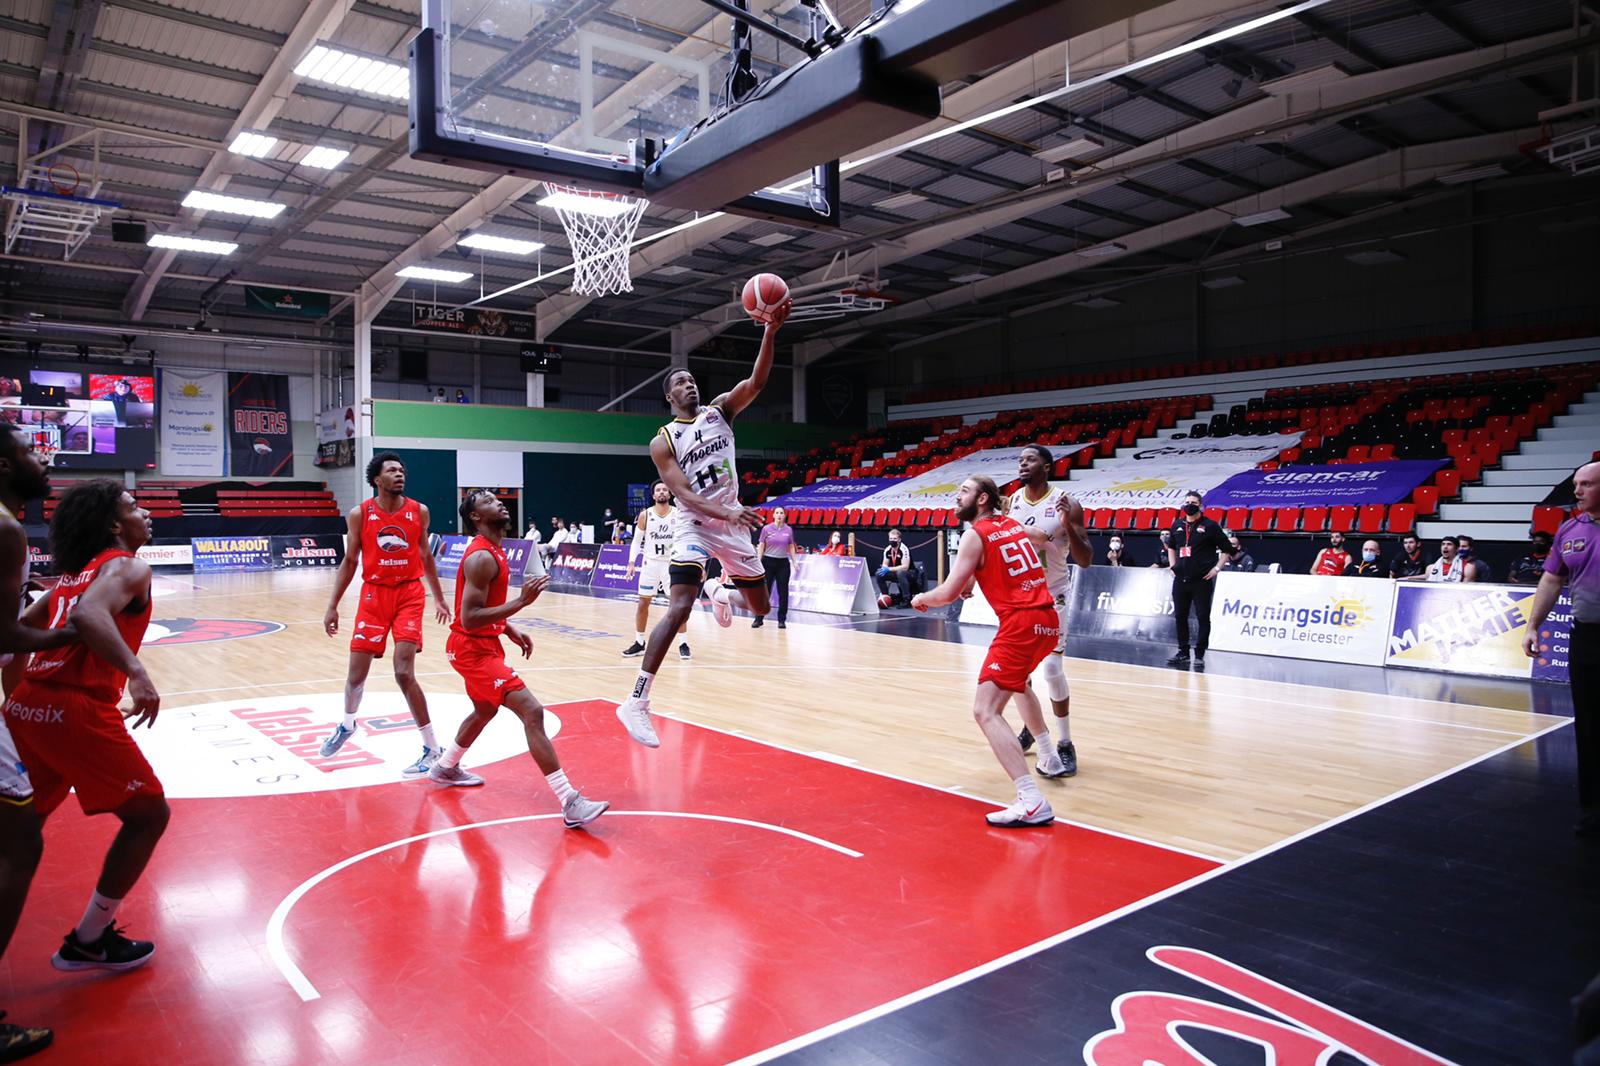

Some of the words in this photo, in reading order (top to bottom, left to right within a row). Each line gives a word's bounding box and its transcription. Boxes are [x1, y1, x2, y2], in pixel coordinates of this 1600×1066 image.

[416, 306, 465, 322] TIGER
[234, 409, 289, 435] RIDERS
[694, 429, 703, 444] 4
[680, 434, 729, 470] Phoenix
[1263, 470, 1387, 483] Glencar
[405, 512, 413, 521] 4
[649, 531, 675, 541] Phoeni
[196, 540, 269, 553] WALKABOUT
[282, 547, 337, 558] Jelson
[136, 550, 175, 559] remier
[378, 558, 409, 566] Jelson
[1000, 537, 1042, 577] 50
[564, 555, 595, 570] Kappa
[1222, 598, 1358, 628] Morningside
[1391, 589, 1517, 655] MATHER
[1240, 622, 1287, 640] Arena
[1291, 628, 1354, 645] Leicester
[1435, 607, 1528, 664] JAMIE
[4, 695, 64, 723] veorsix
